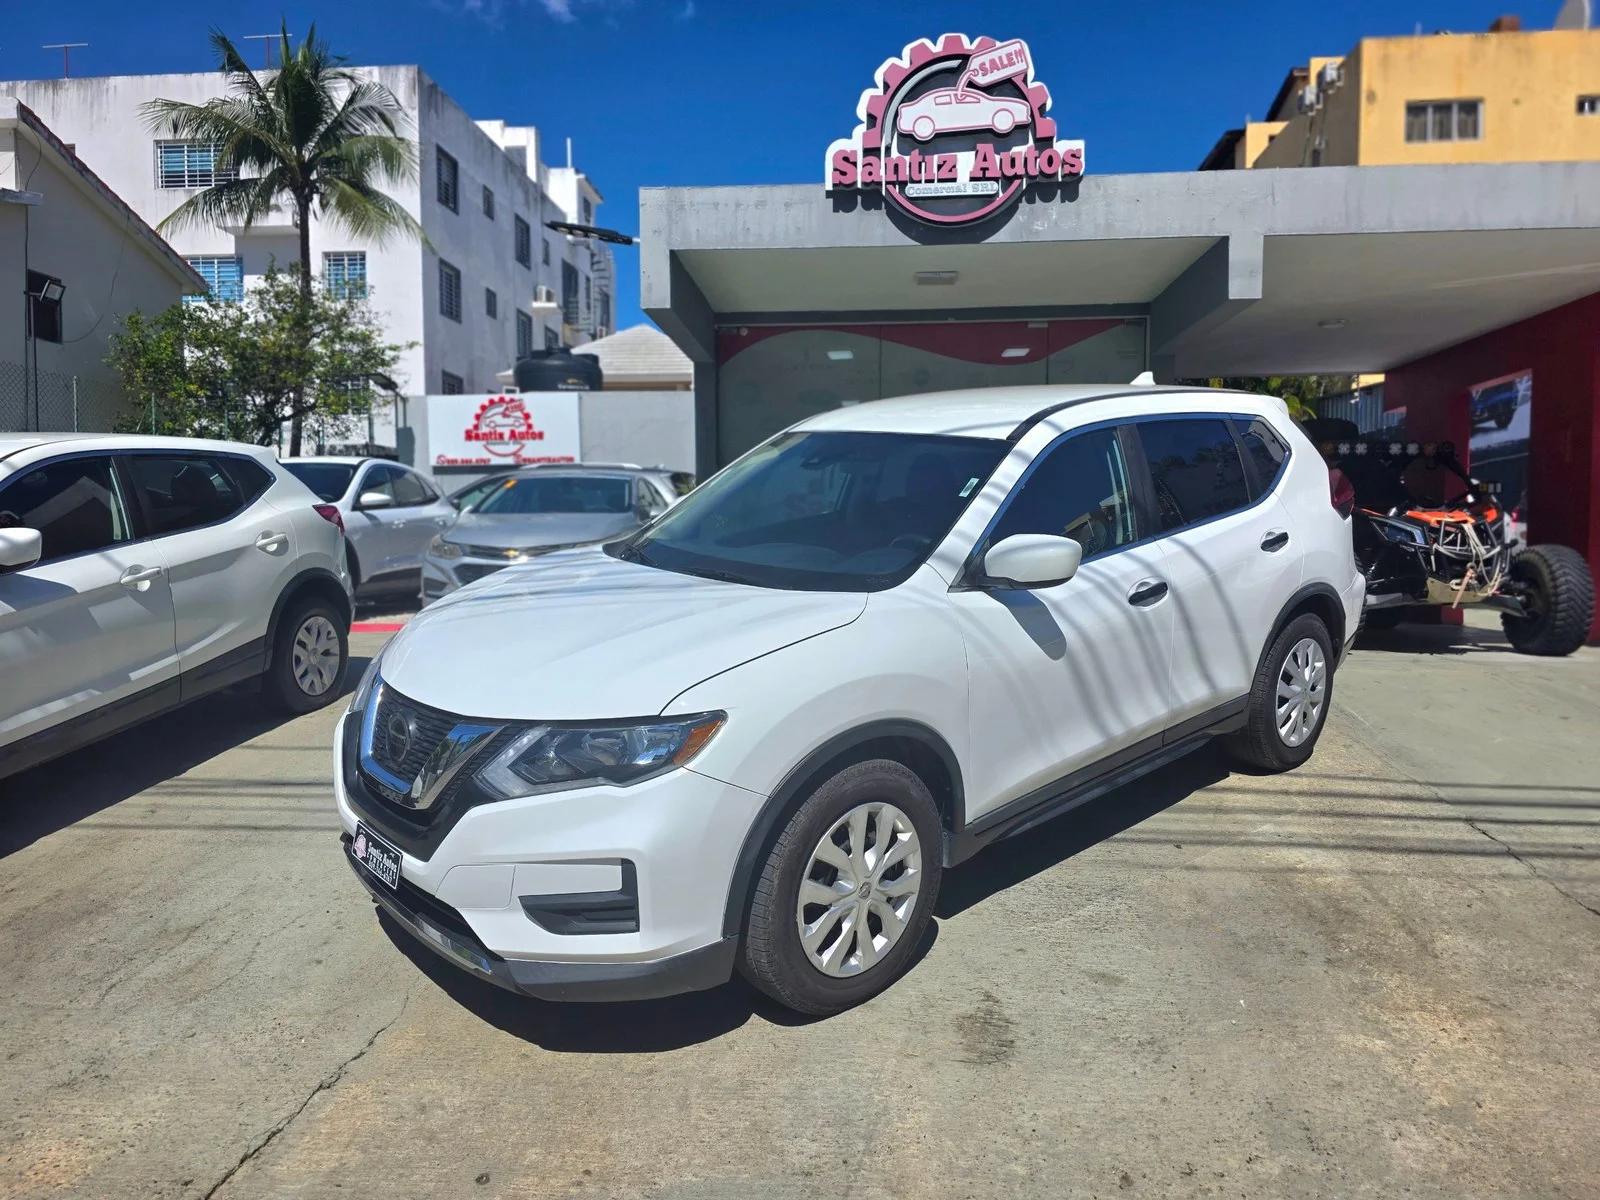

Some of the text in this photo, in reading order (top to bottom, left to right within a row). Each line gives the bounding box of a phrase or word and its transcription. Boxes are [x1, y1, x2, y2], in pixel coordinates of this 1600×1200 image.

[978, 49, 1025, 77] SALE!!
[832, 143, 1083, 185] Santiz Autos
[971, 181, 999, 194] SRL
[509, 428, 544, 441] Autos
